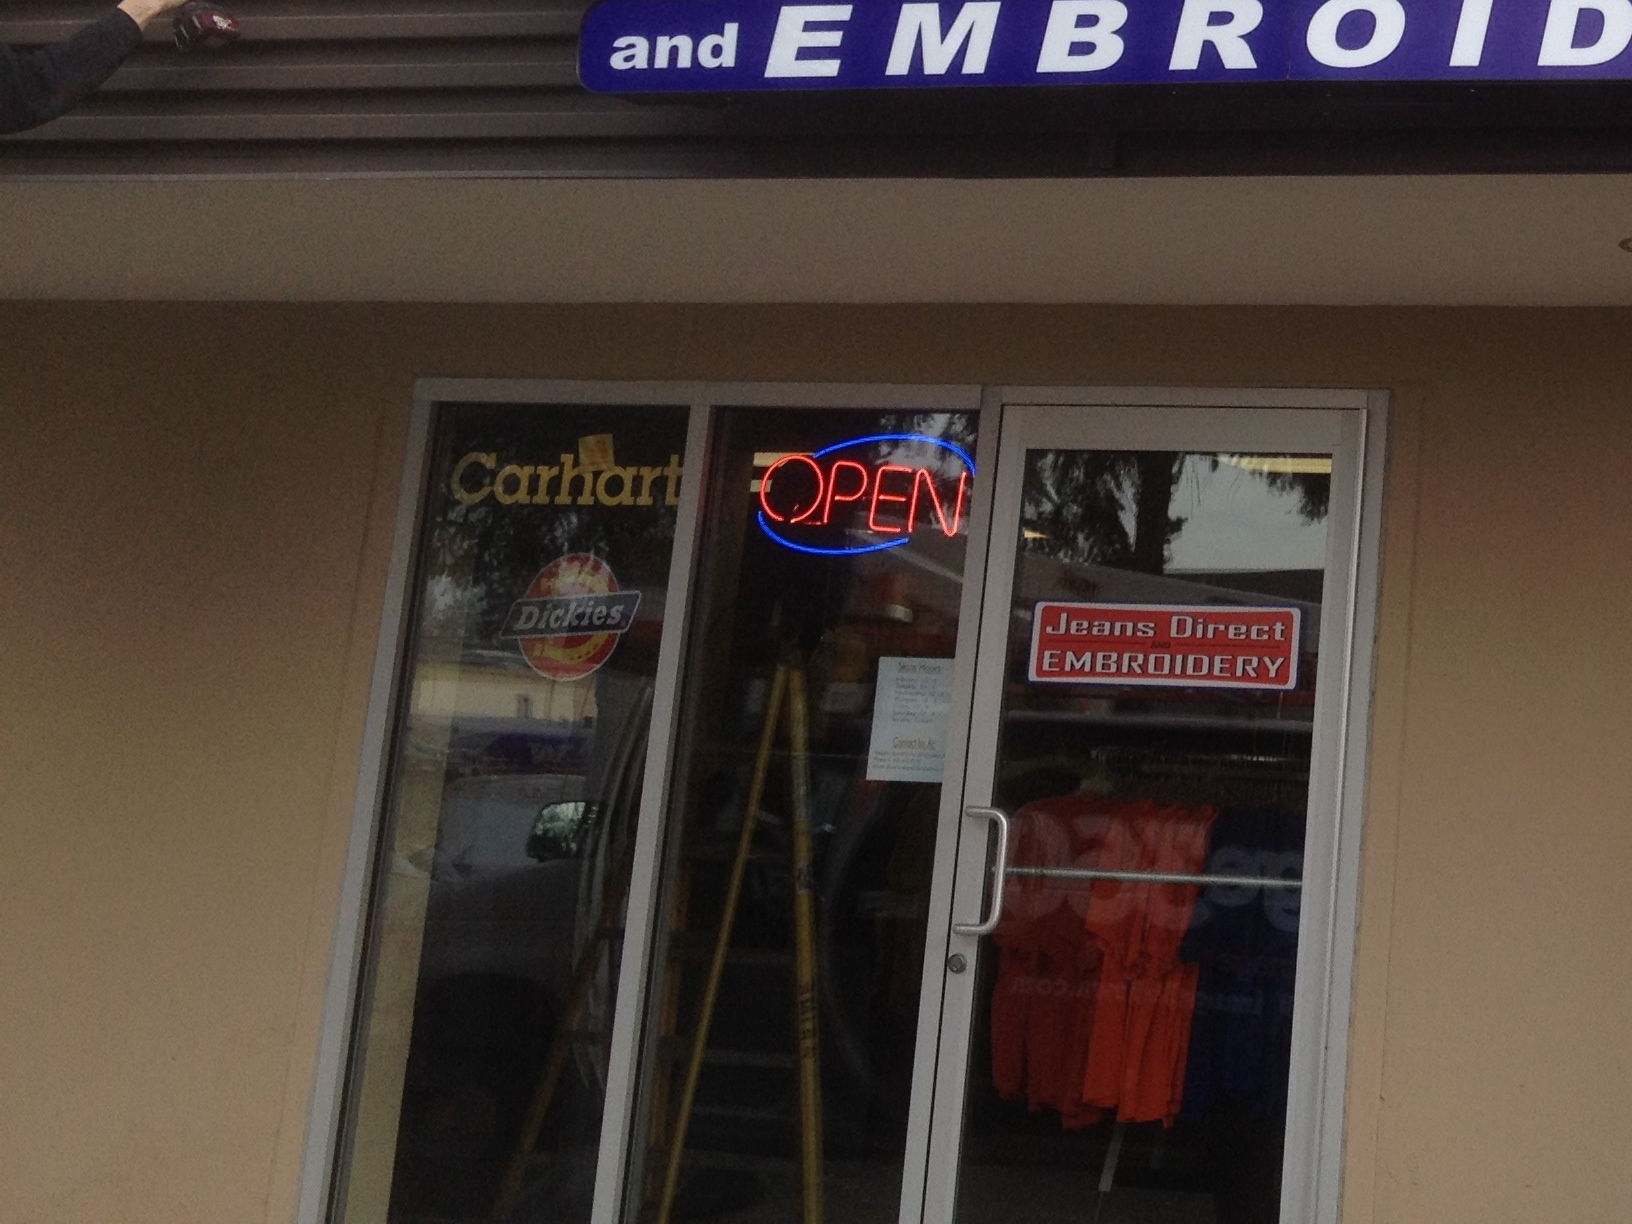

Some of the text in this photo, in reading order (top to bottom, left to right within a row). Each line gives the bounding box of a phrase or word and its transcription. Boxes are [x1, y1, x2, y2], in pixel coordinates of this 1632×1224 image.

[609, 22, 738, 70] and
[759, 454, 968, 538] OPEN
[512, 599, 625, 632] Dickies
[1045, 612, 1287, 641] Jeans Direct
[1041, 649, 1286, 679] EMBROIDERY
